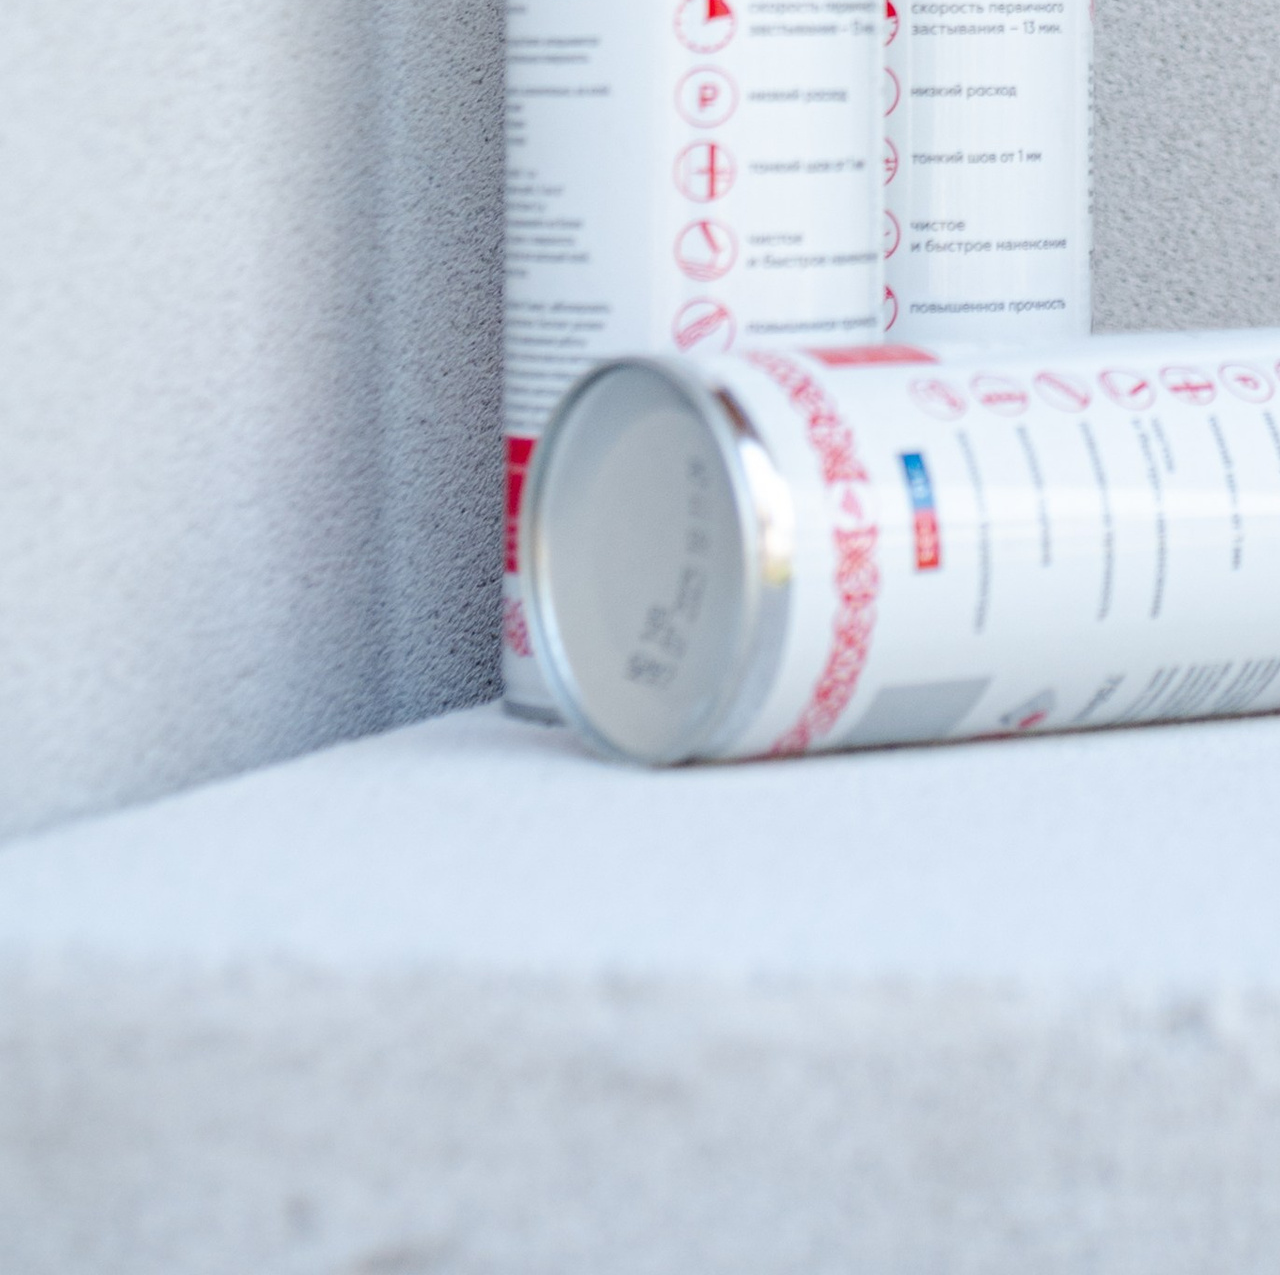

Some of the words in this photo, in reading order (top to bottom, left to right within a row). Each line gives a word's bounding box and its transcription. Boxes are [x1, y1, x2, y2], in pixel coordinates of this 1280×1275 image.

[911, 2, 984, 18] скорость
[988, 2, 1064, 17] первичного
[911, 23, 1005, 37] застывания
[1022, 21, 1035, 35] 13
[910, 84, 962, 99] низкий
[966, 84, 1017, 100] расход
[911, 151, 963, 165] тонкий
[967, 152, 998, 164] шов
[910, 219, 966, 233] чистое
[924, 237, 992, 255] быстрое
[909, 301, 1005, 317] повышенная
[1007, 298, 1066, 315] прочность
